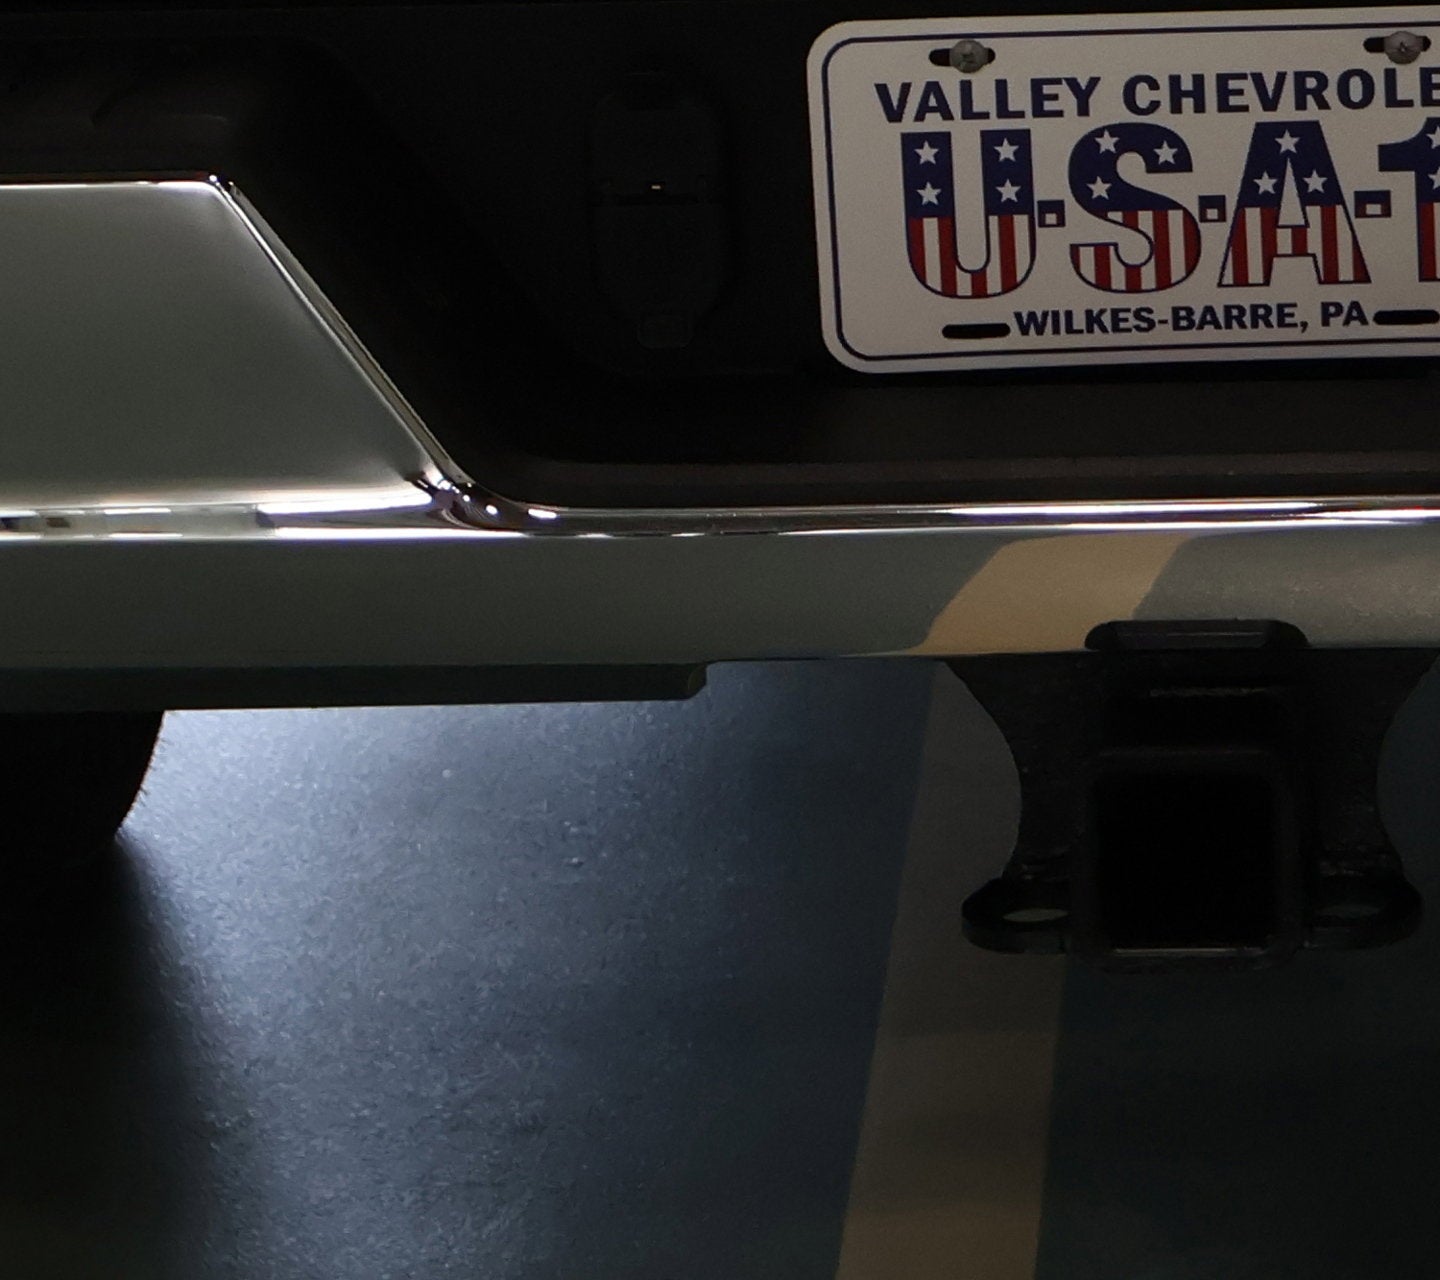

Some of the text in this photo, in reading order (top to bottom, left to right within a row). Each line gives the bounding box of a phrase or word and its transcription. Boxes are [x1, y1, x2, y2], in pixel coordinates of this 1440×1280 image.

[874, 76, 1102, 124] VALLEY
[1013, 301, 1370, 338] WILKES-BARRE, PA
